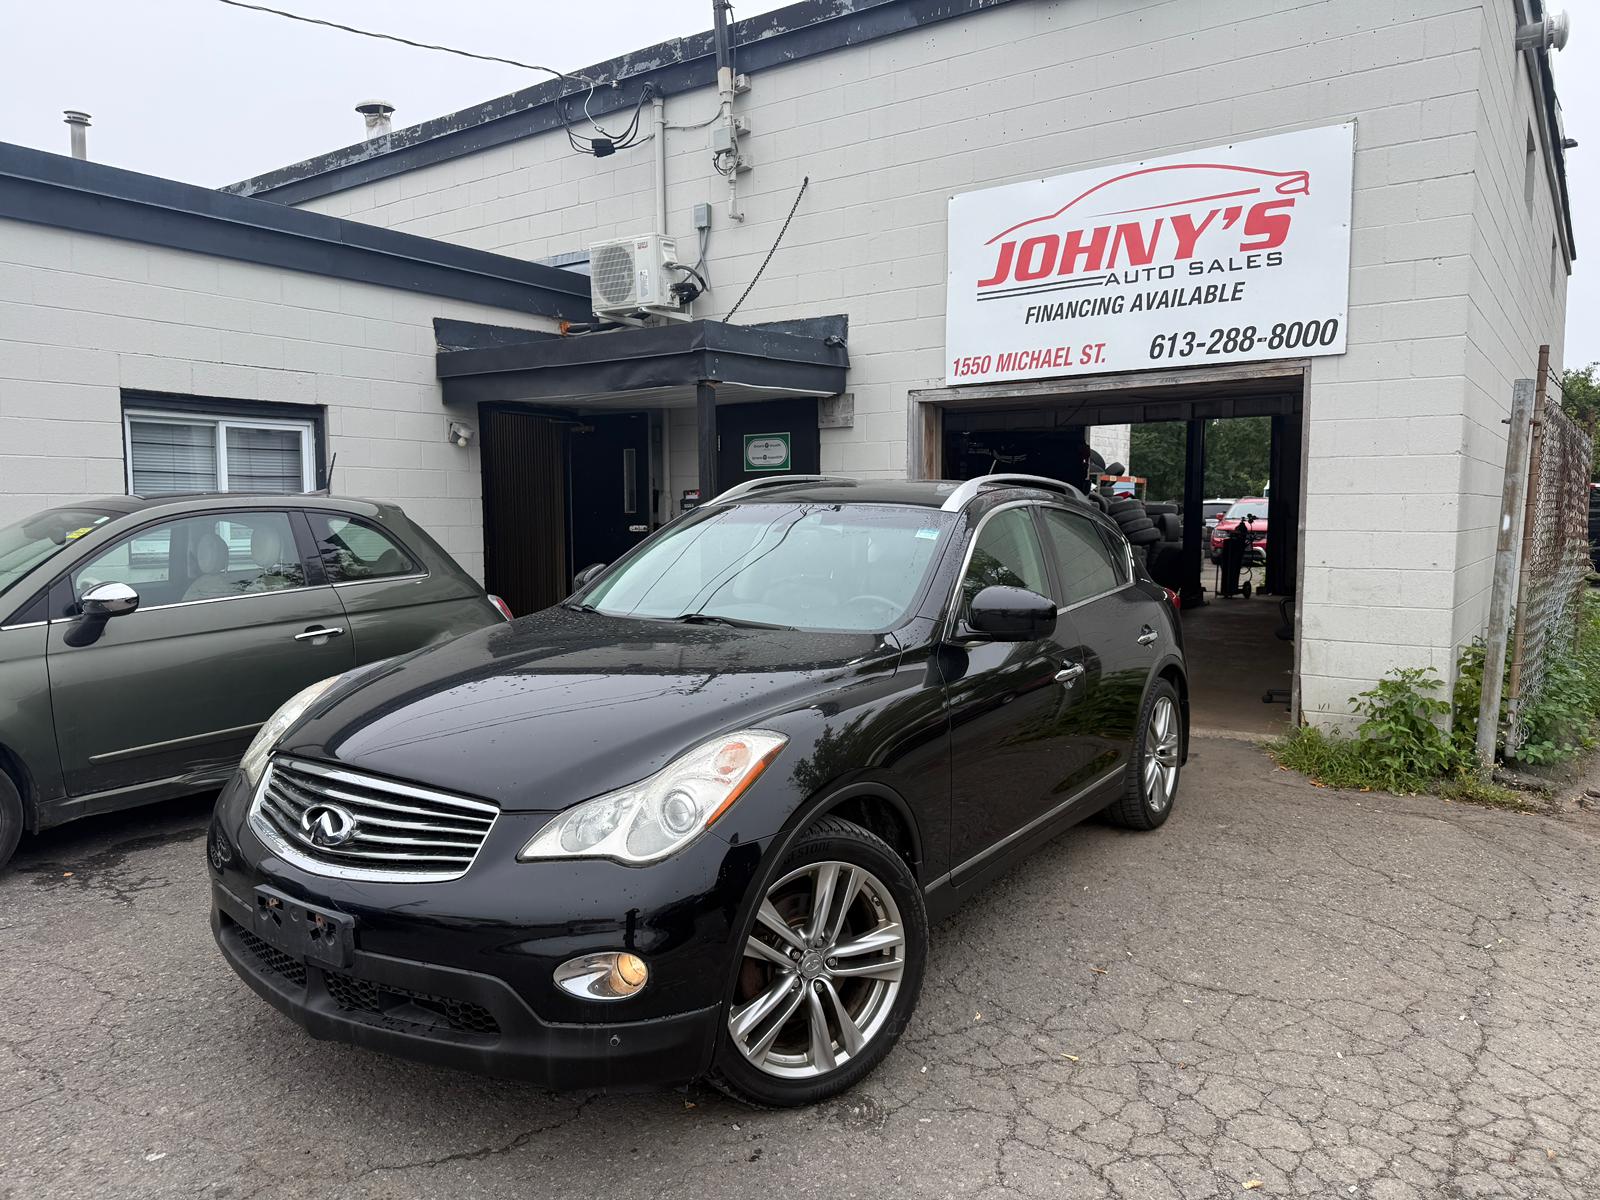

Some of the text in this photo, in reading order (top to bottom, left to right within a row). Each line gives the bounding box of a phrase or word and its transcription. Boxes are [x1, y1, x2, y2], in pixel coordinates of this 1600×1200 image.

[1104, 251, 1283, 287] AUTO SALES
[1025, 281, 1246, 325] FINANCING AVAILABLE
[1149, 318, 1339, 360] 613-288-8000
[953, 342, 1106, 377] 1550 MICHAEL ST.
